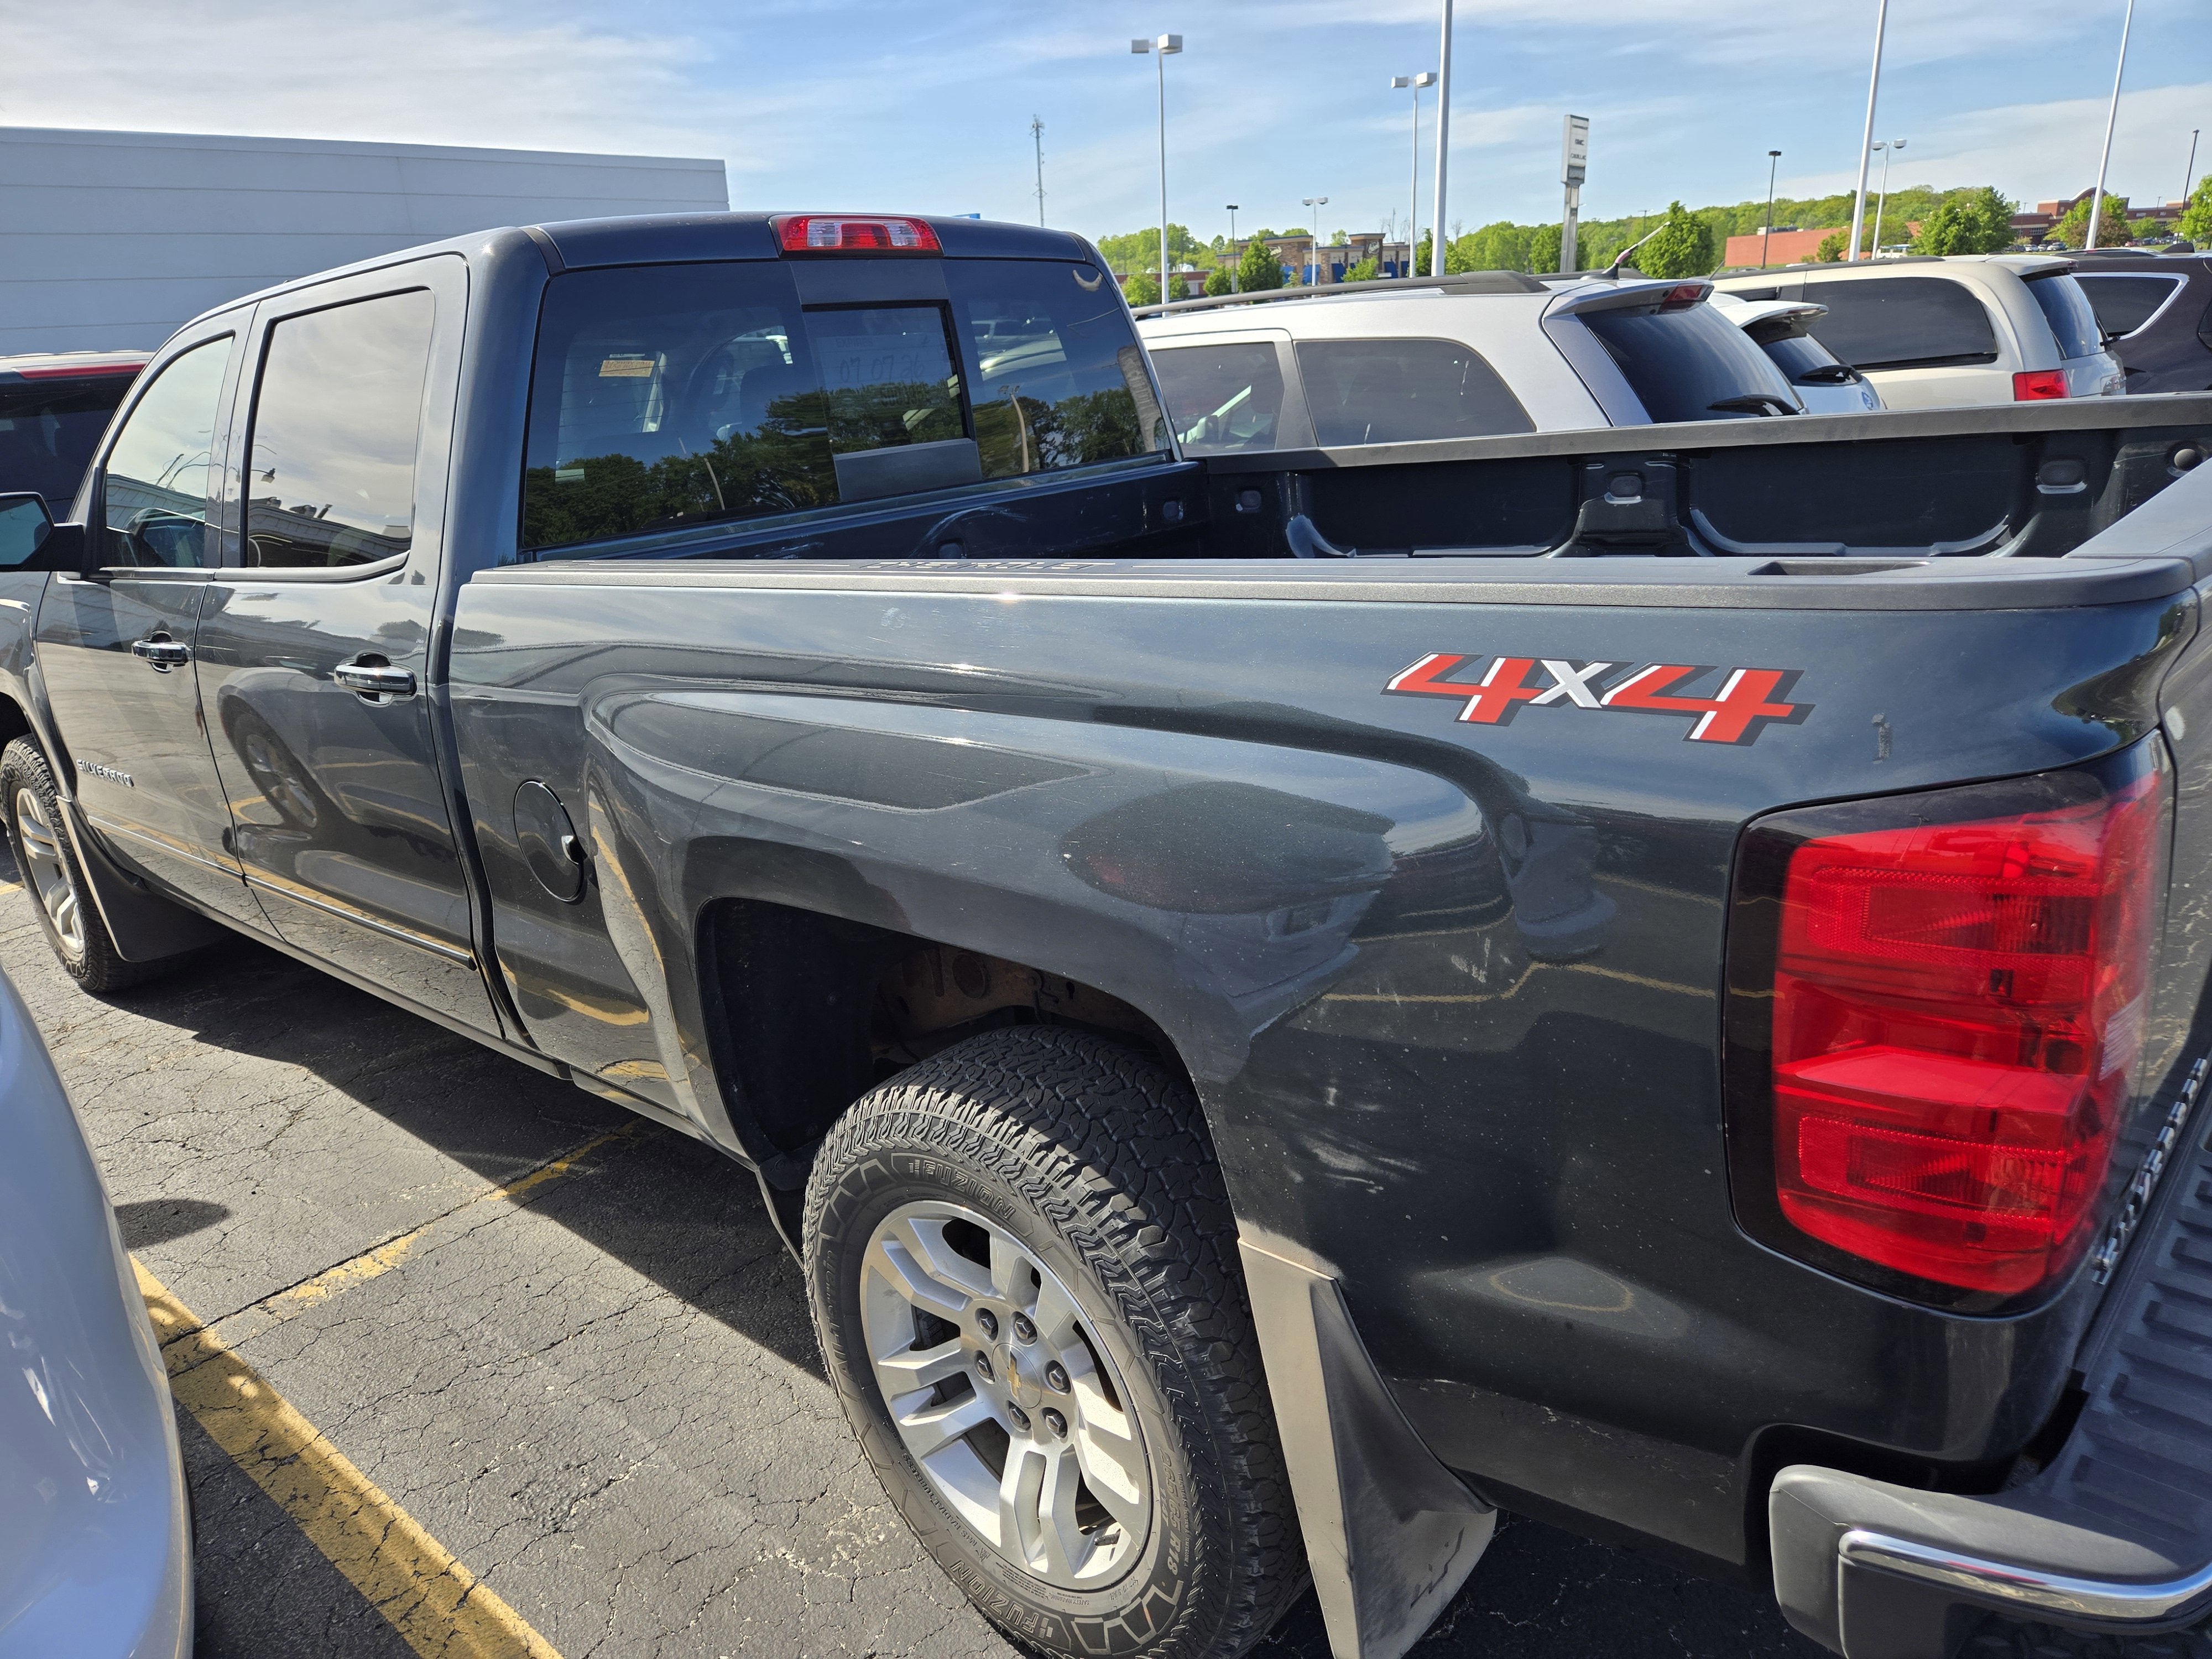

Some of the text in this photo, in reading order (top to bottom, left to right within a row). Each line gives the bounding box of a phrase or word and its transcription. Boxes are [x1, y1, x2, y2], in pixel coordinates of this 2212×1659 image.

[76, 759, 134, 787] SILVERADO
[922, 1159, 1016, 1220] FUZION
[901, 1452, 936, 1502] TUBELESS
[931, 1499, 961, 1531] RADIAL
[1167, 1530, 1182, 1575] R18
[950, 1559, 1039, 1634] FUZION
